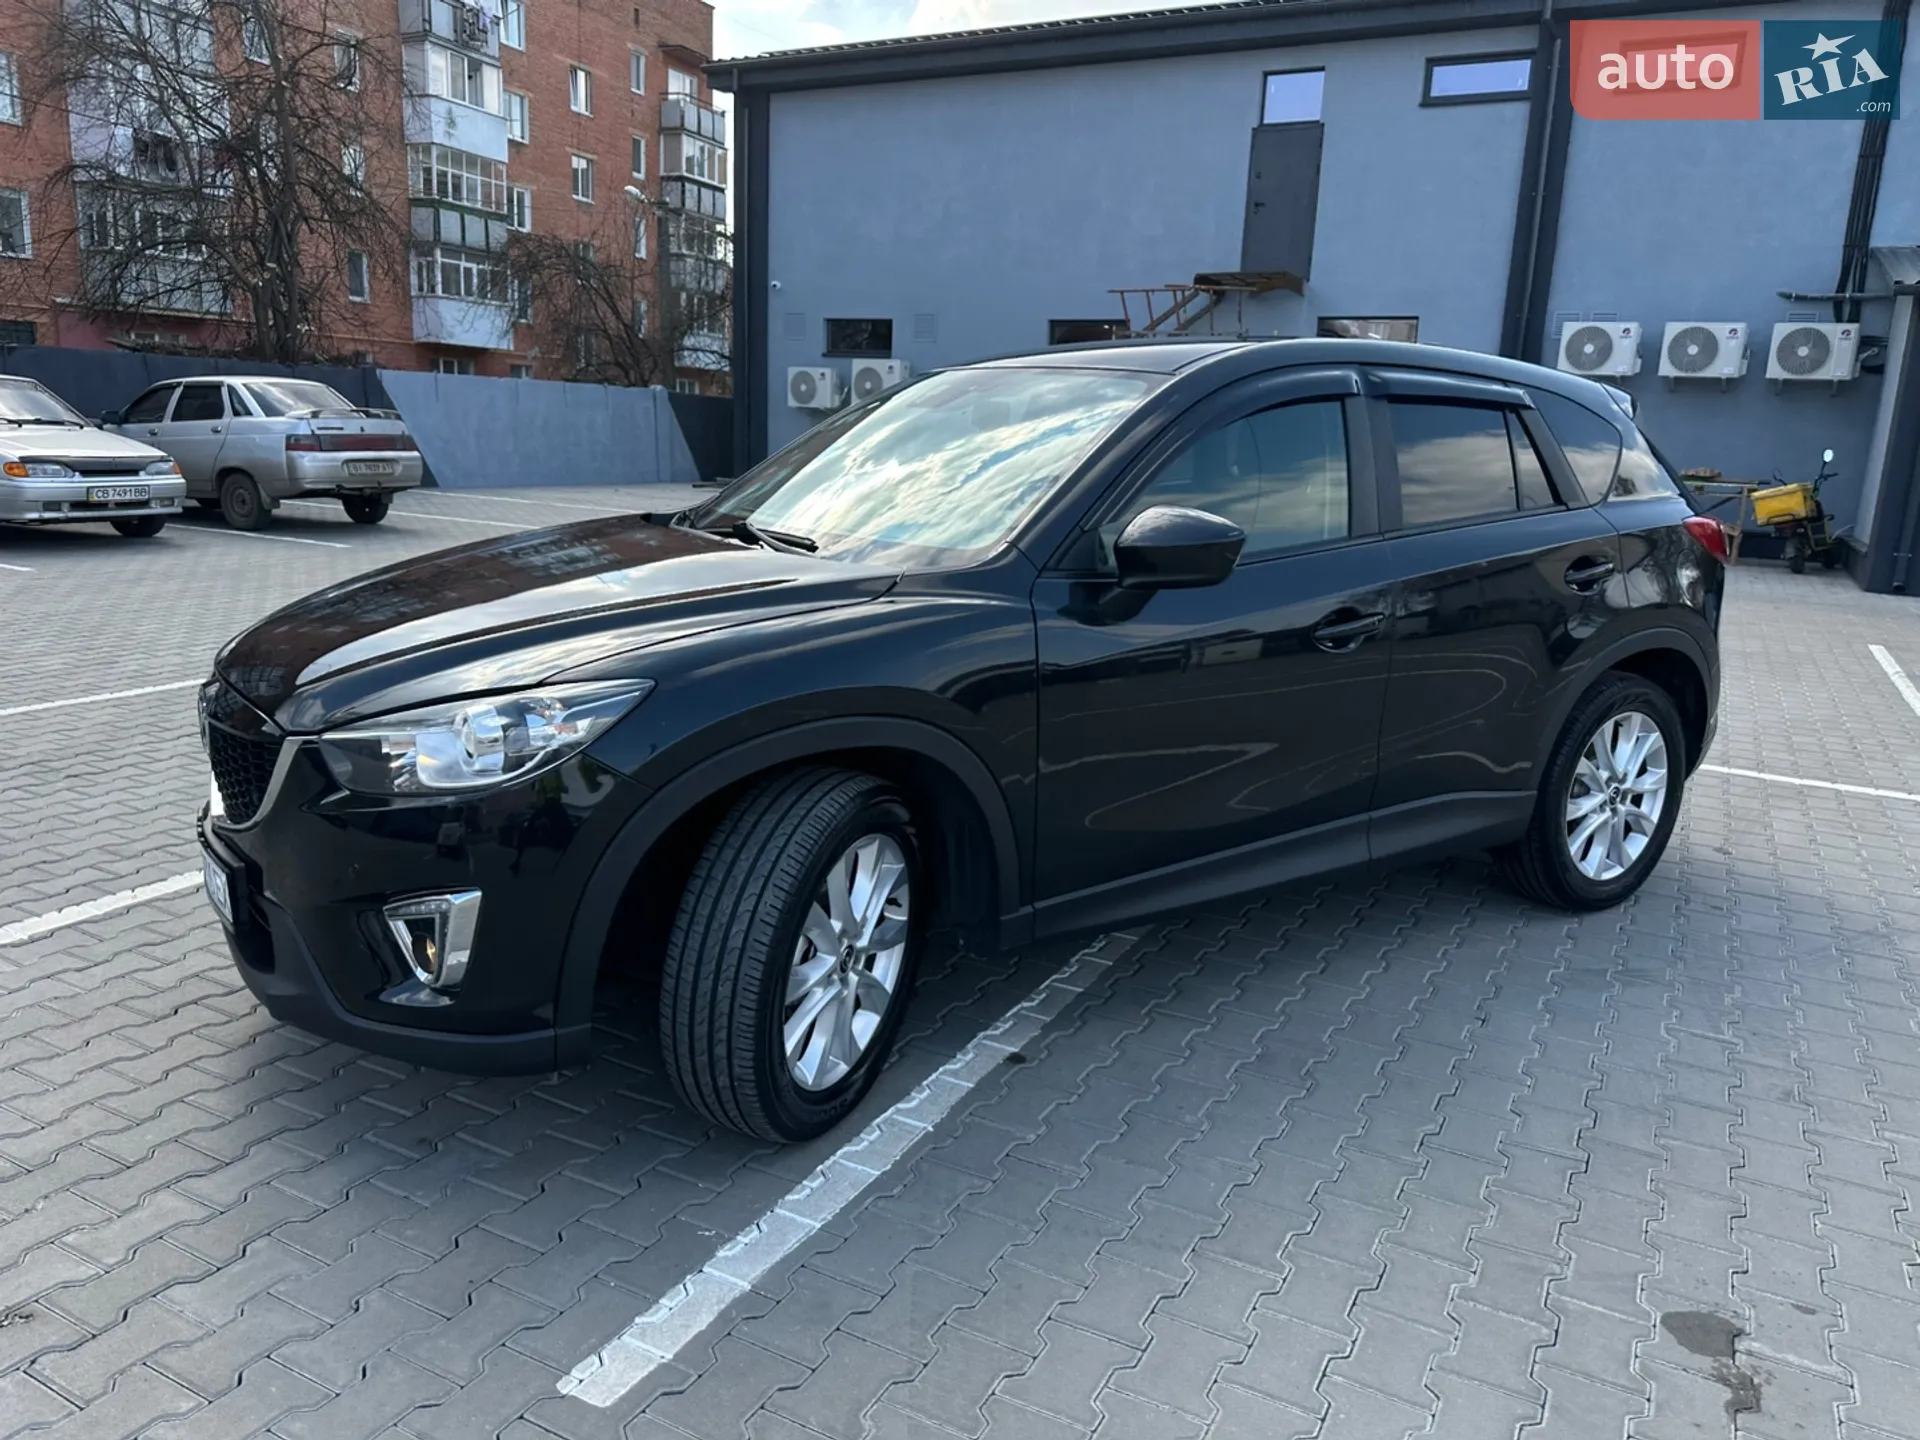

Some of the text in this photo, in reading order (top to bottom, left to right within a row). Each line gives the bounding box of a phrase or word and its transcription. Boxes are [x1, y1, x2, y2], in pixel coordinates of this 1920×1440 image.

[95, 487, 147, 499] CB 7491 BB
